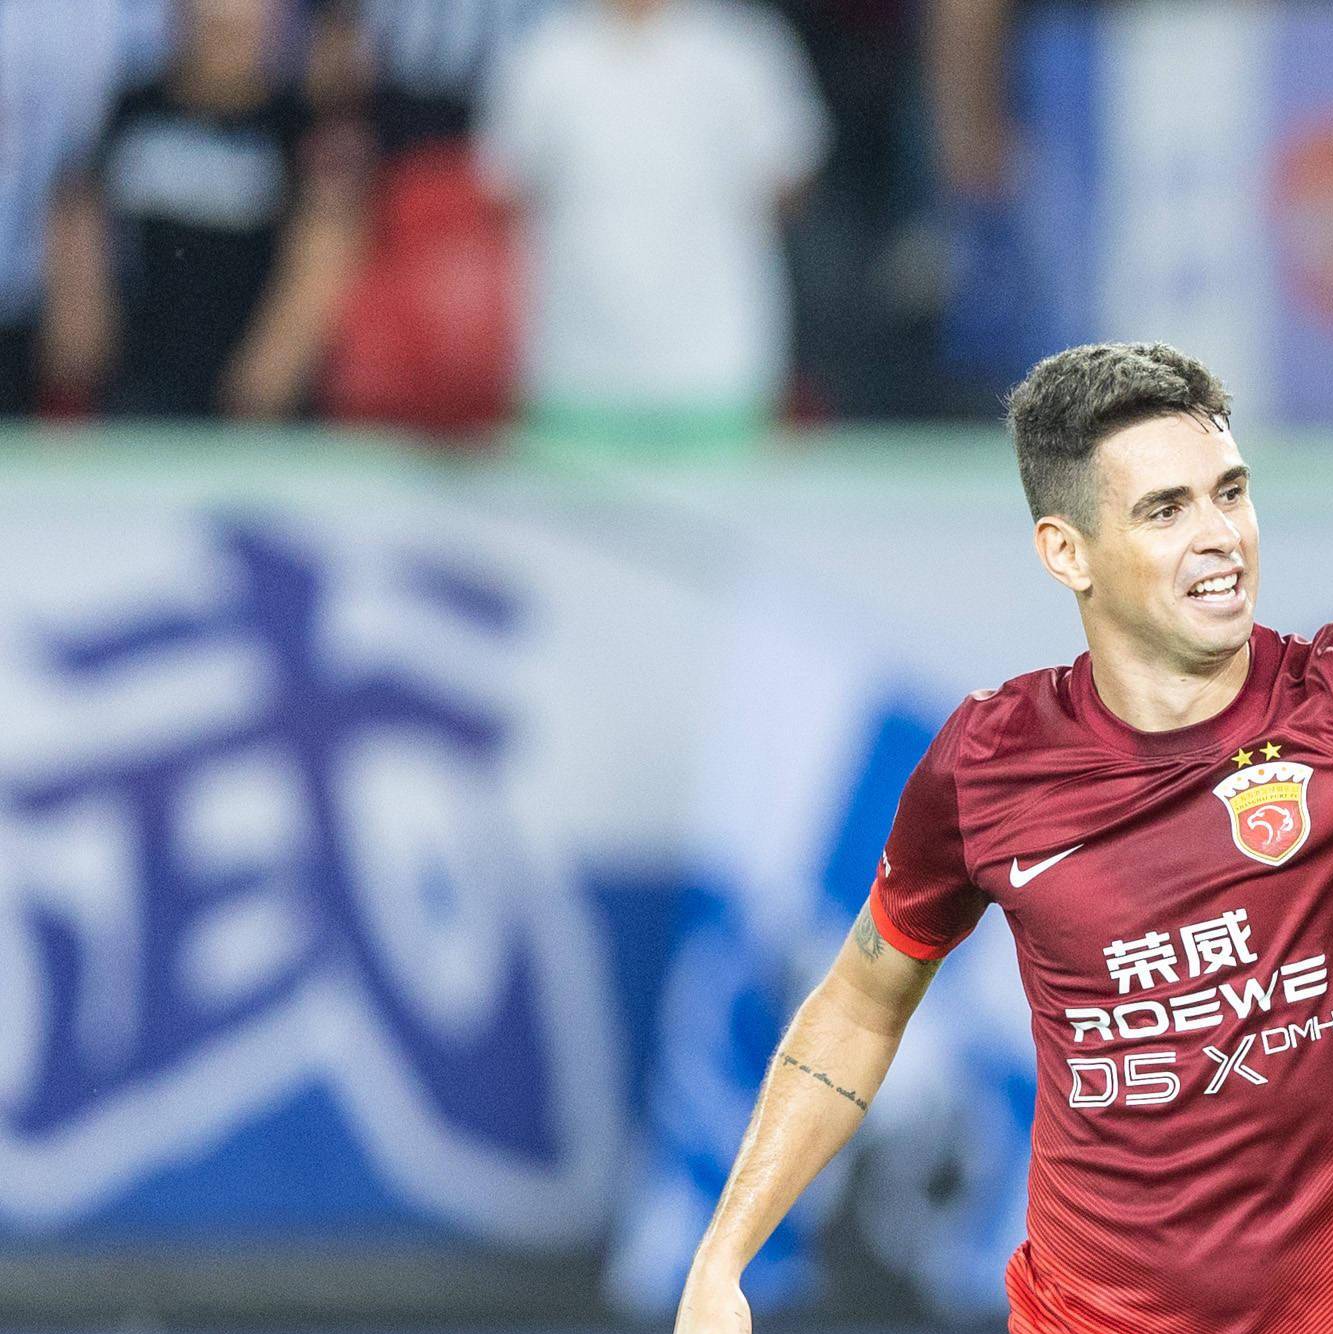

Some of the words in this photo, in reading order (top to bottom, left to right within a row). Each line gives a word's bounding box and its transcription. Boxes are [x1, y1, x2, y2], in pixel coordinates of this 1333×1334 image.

[1102, 907, 1258, 995] 荣威
[1064, 953, 1329, 1043] ROEWE
[1066, 1051, 1181, 1108] D5
